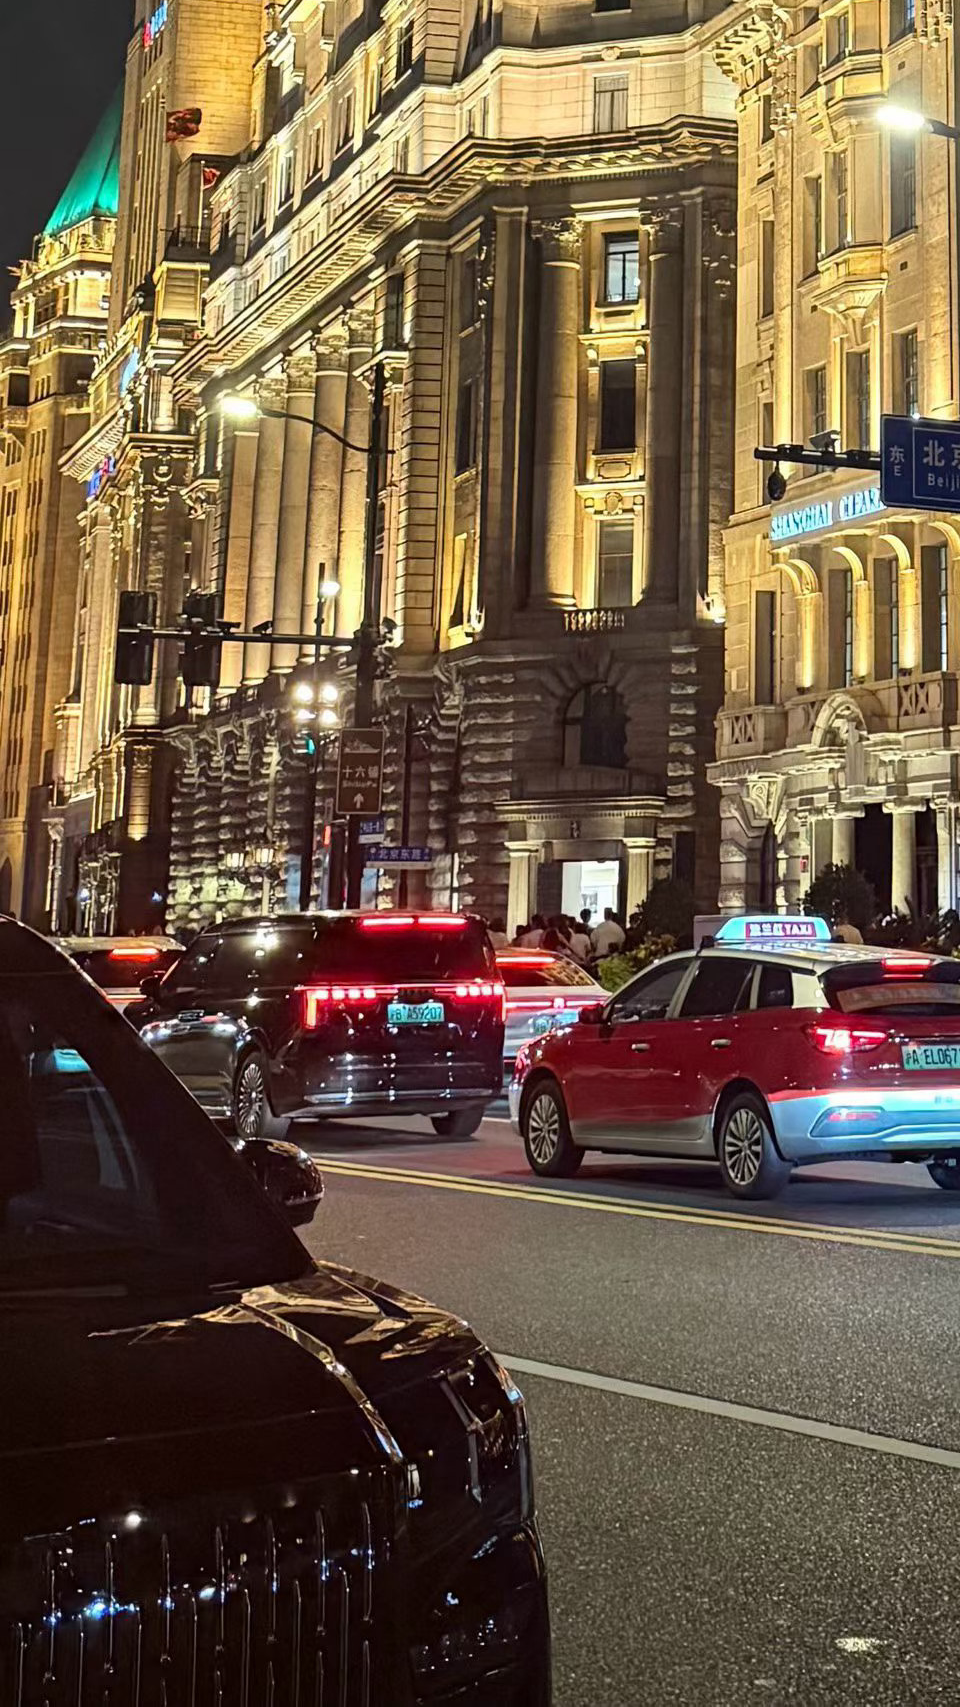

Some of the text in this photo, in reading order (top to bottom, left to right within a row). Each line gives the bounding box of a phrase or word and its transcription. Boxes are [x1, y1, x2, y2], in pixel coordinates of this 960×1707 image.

[889, 445, 905, 463] 东
[893, 464, 902, 476] E
[770, 500, 834, 541] SHANGHAI
